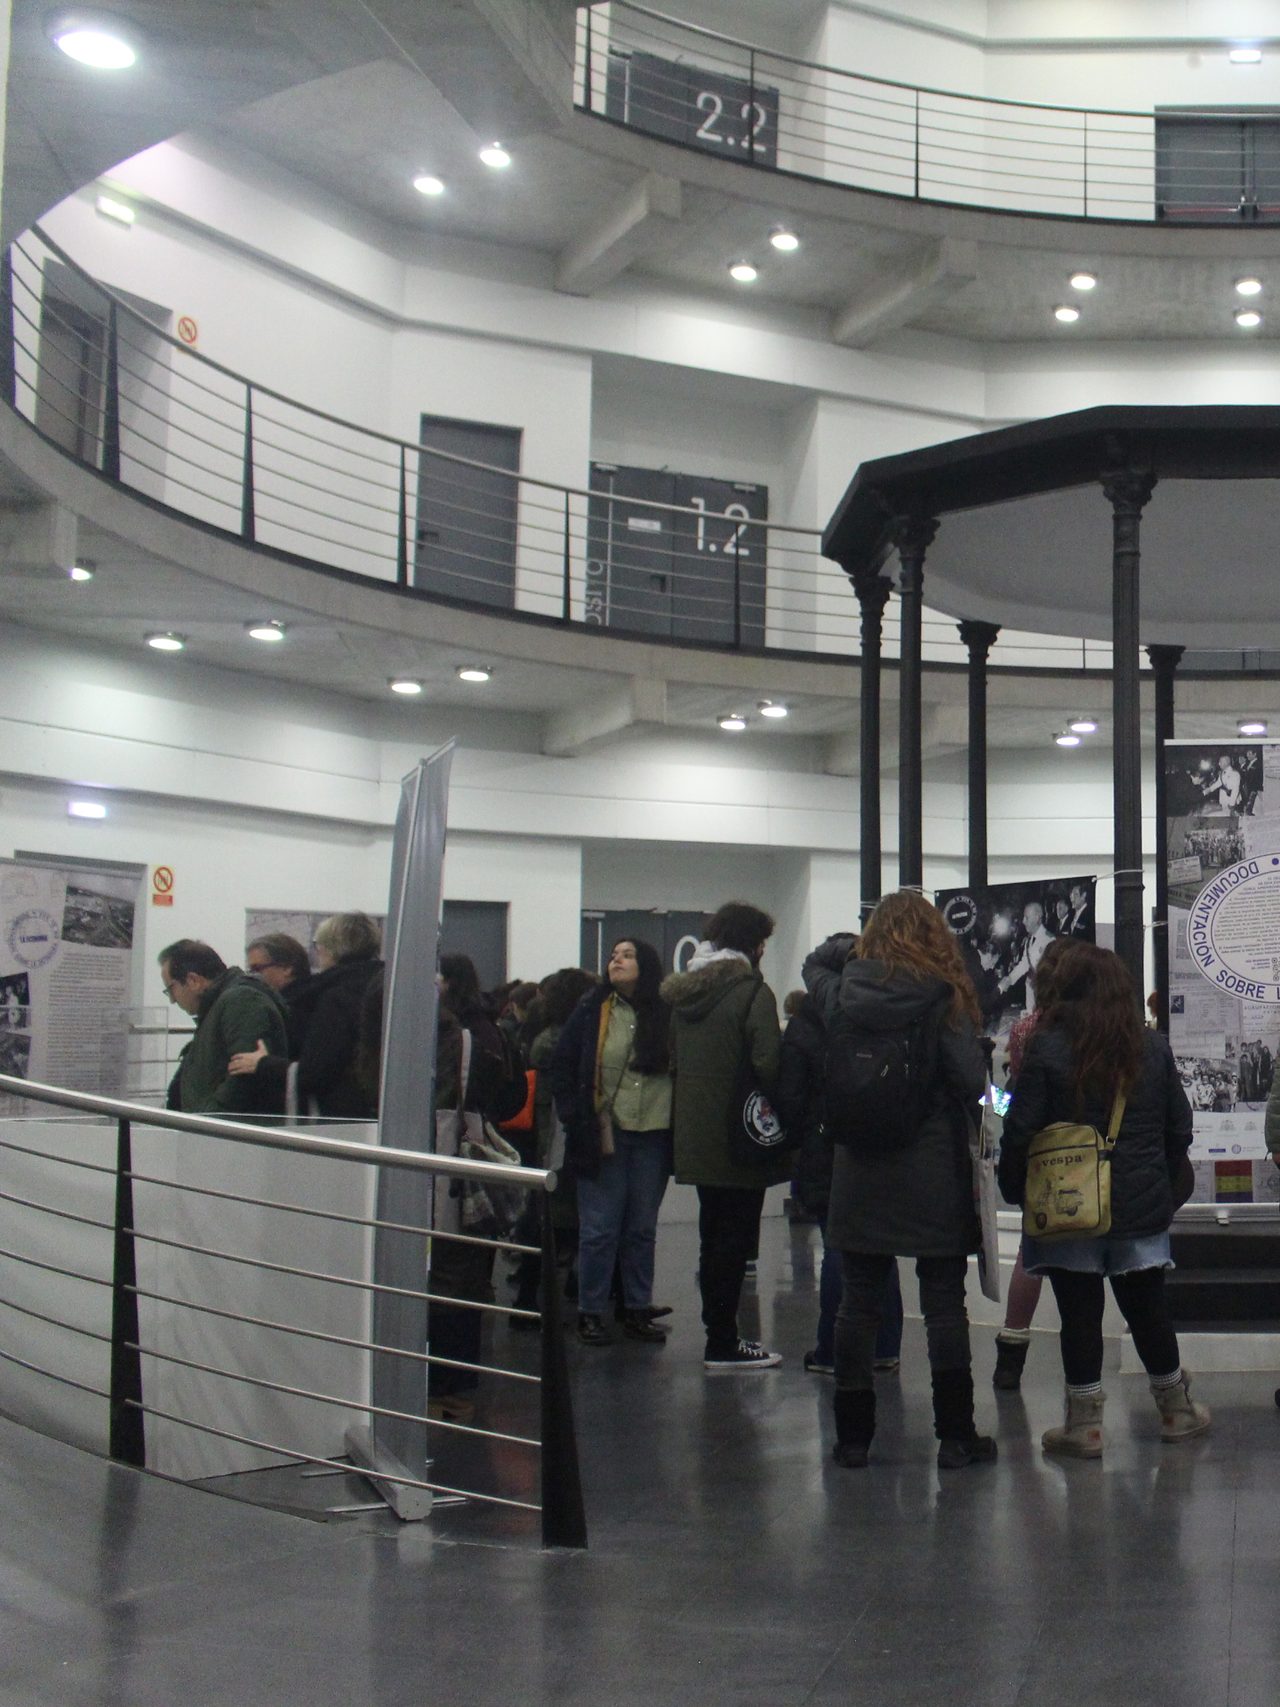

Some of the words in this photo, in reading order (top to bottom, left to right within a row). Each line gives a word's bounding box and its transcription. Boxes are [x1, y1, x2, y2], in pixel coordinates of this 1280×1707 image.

[696, 91, 767, 153] 2.2
[691, 496, 750, 556] 1.2
[1192, 860, 1260, 968] DOCUMENTACIÓN
[1216, 969, 1266, 999] SOBRE
[1042, 1154, 1083, 1167] vespa
